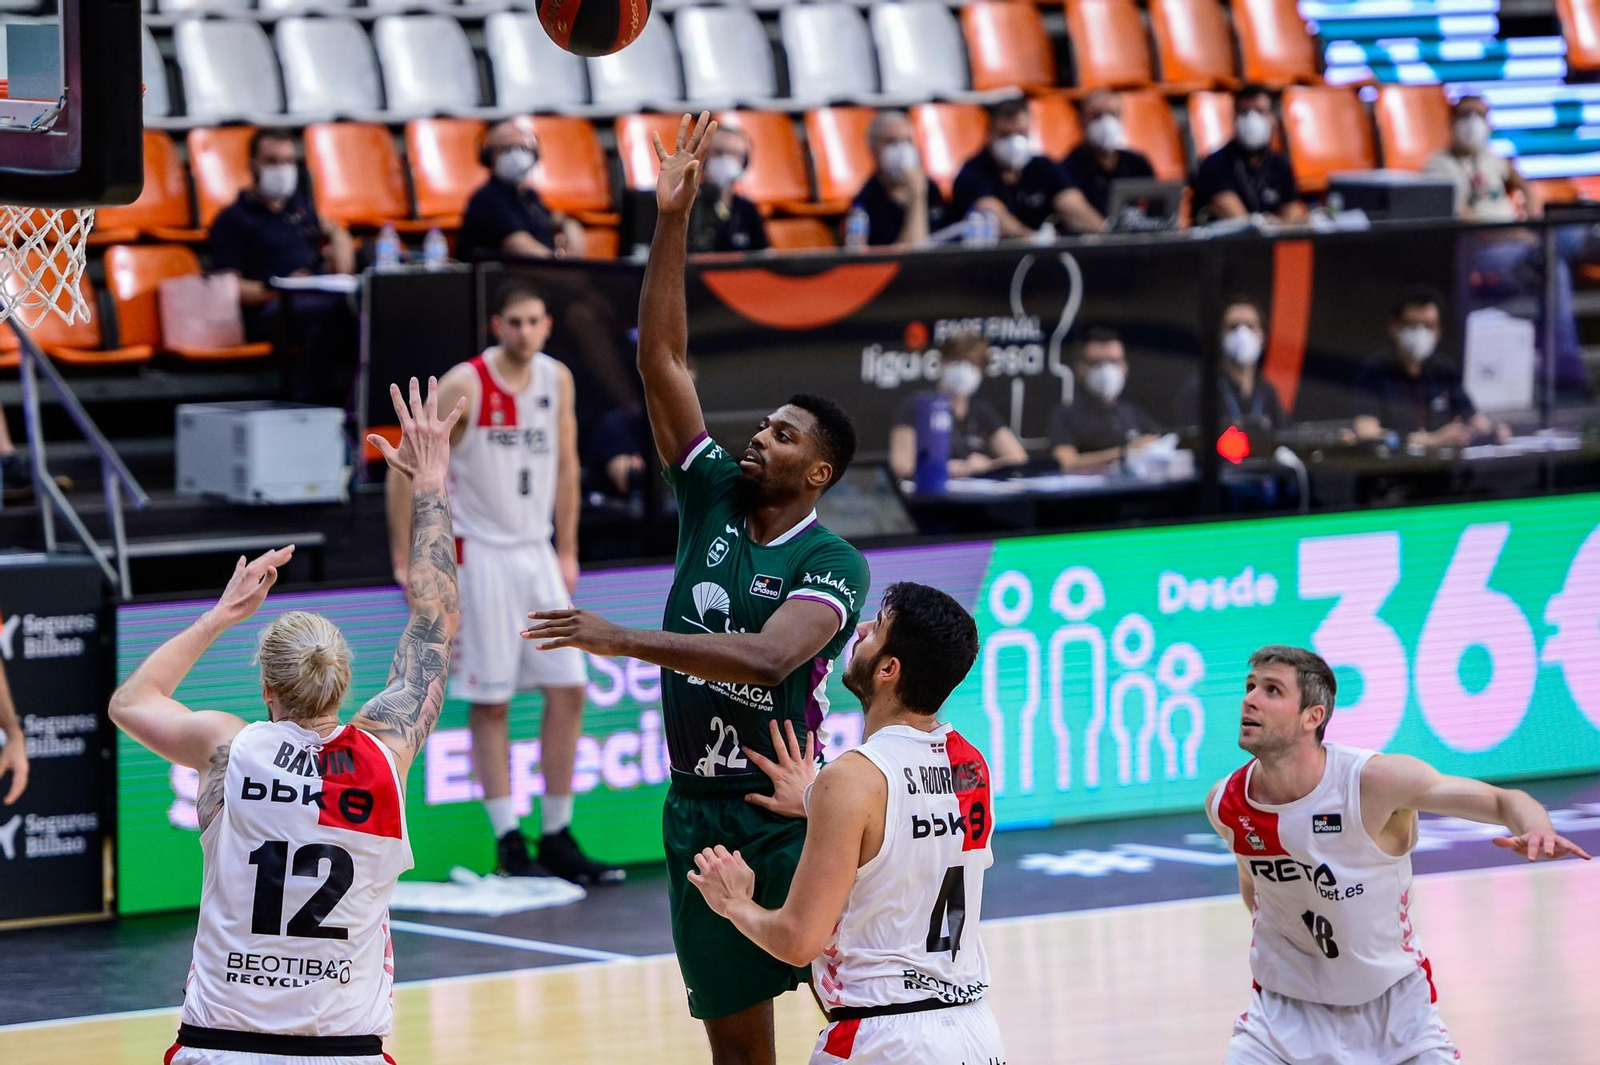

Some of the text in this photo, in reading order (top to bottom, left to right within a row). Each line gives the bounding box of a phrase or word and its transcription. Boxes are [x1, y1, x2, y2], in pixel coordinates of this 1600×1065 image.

[1157, 566, 1280, 613] Desde
[23, 613, 97, 639] Seguros
[23, 636, 86, 660] Bilbao
[758, 704, 774, 712] SPORT
[24, 713, 98, 740] Seguros
[903, 766, 921, 795] S.
[25, 812, 99, 837] Seguros
[25, 835, 87, 859] Bilbao
[1250, 858, 1337, 893] RETA
[248, 840, 355, 941] 12
[1319, 883, 1364, 901] bet.es
[926, 865, 966, 963] 4
[1301, 909, 1340, 960] 18
